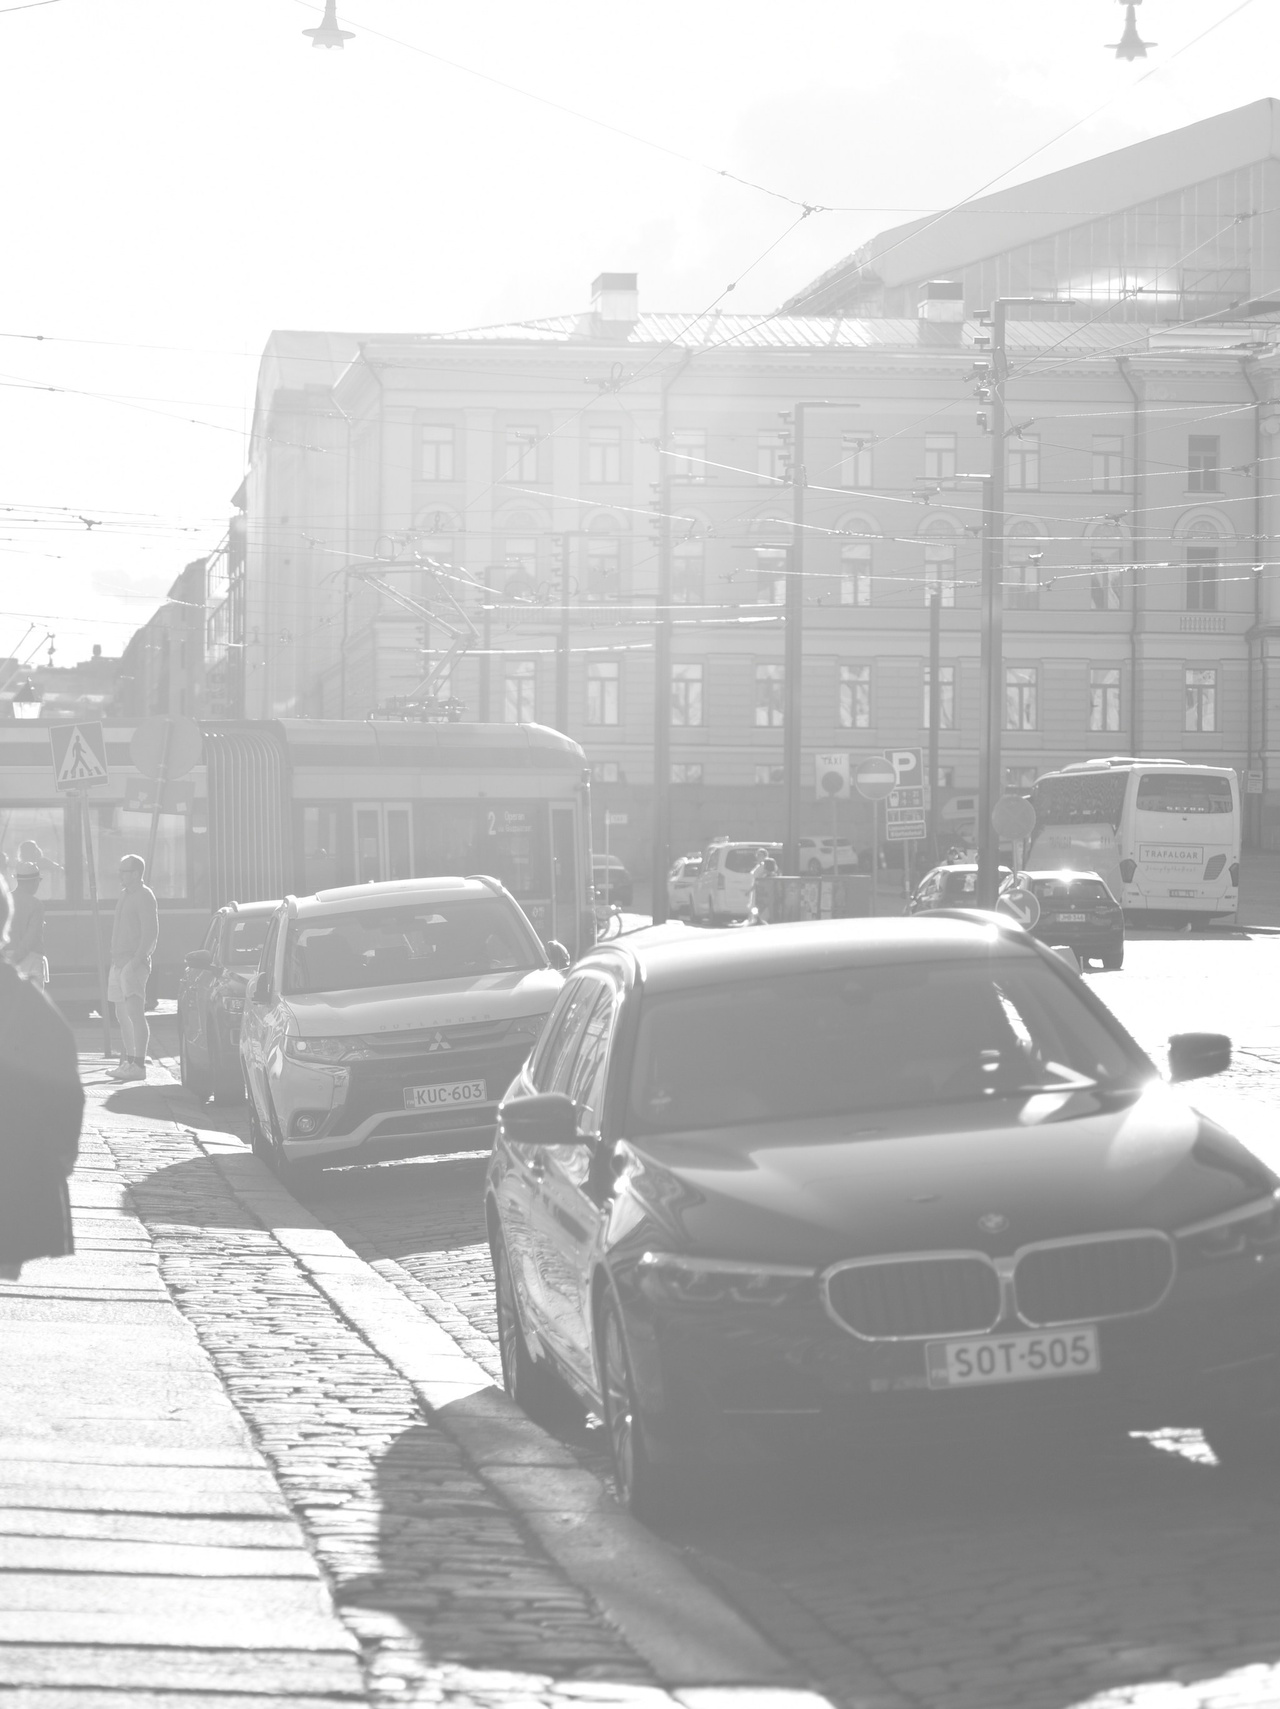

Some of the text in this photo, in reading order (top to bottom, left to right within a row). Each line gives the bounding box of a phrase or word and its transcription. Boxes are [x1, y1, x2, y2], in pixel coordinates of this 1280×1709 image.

[821, 757, 842, 766] TAXI
[892, 752, 916, 785] P
[487, 811, 497, 835] 2
[1145, 849, 1198, 859] TRAFALGAR
[379, 1014, 490, 1030] OUTLANDER
[416, 1084, 482, 1104] KUC-603
[955, 1335, 1090, 1377] SOT-505
